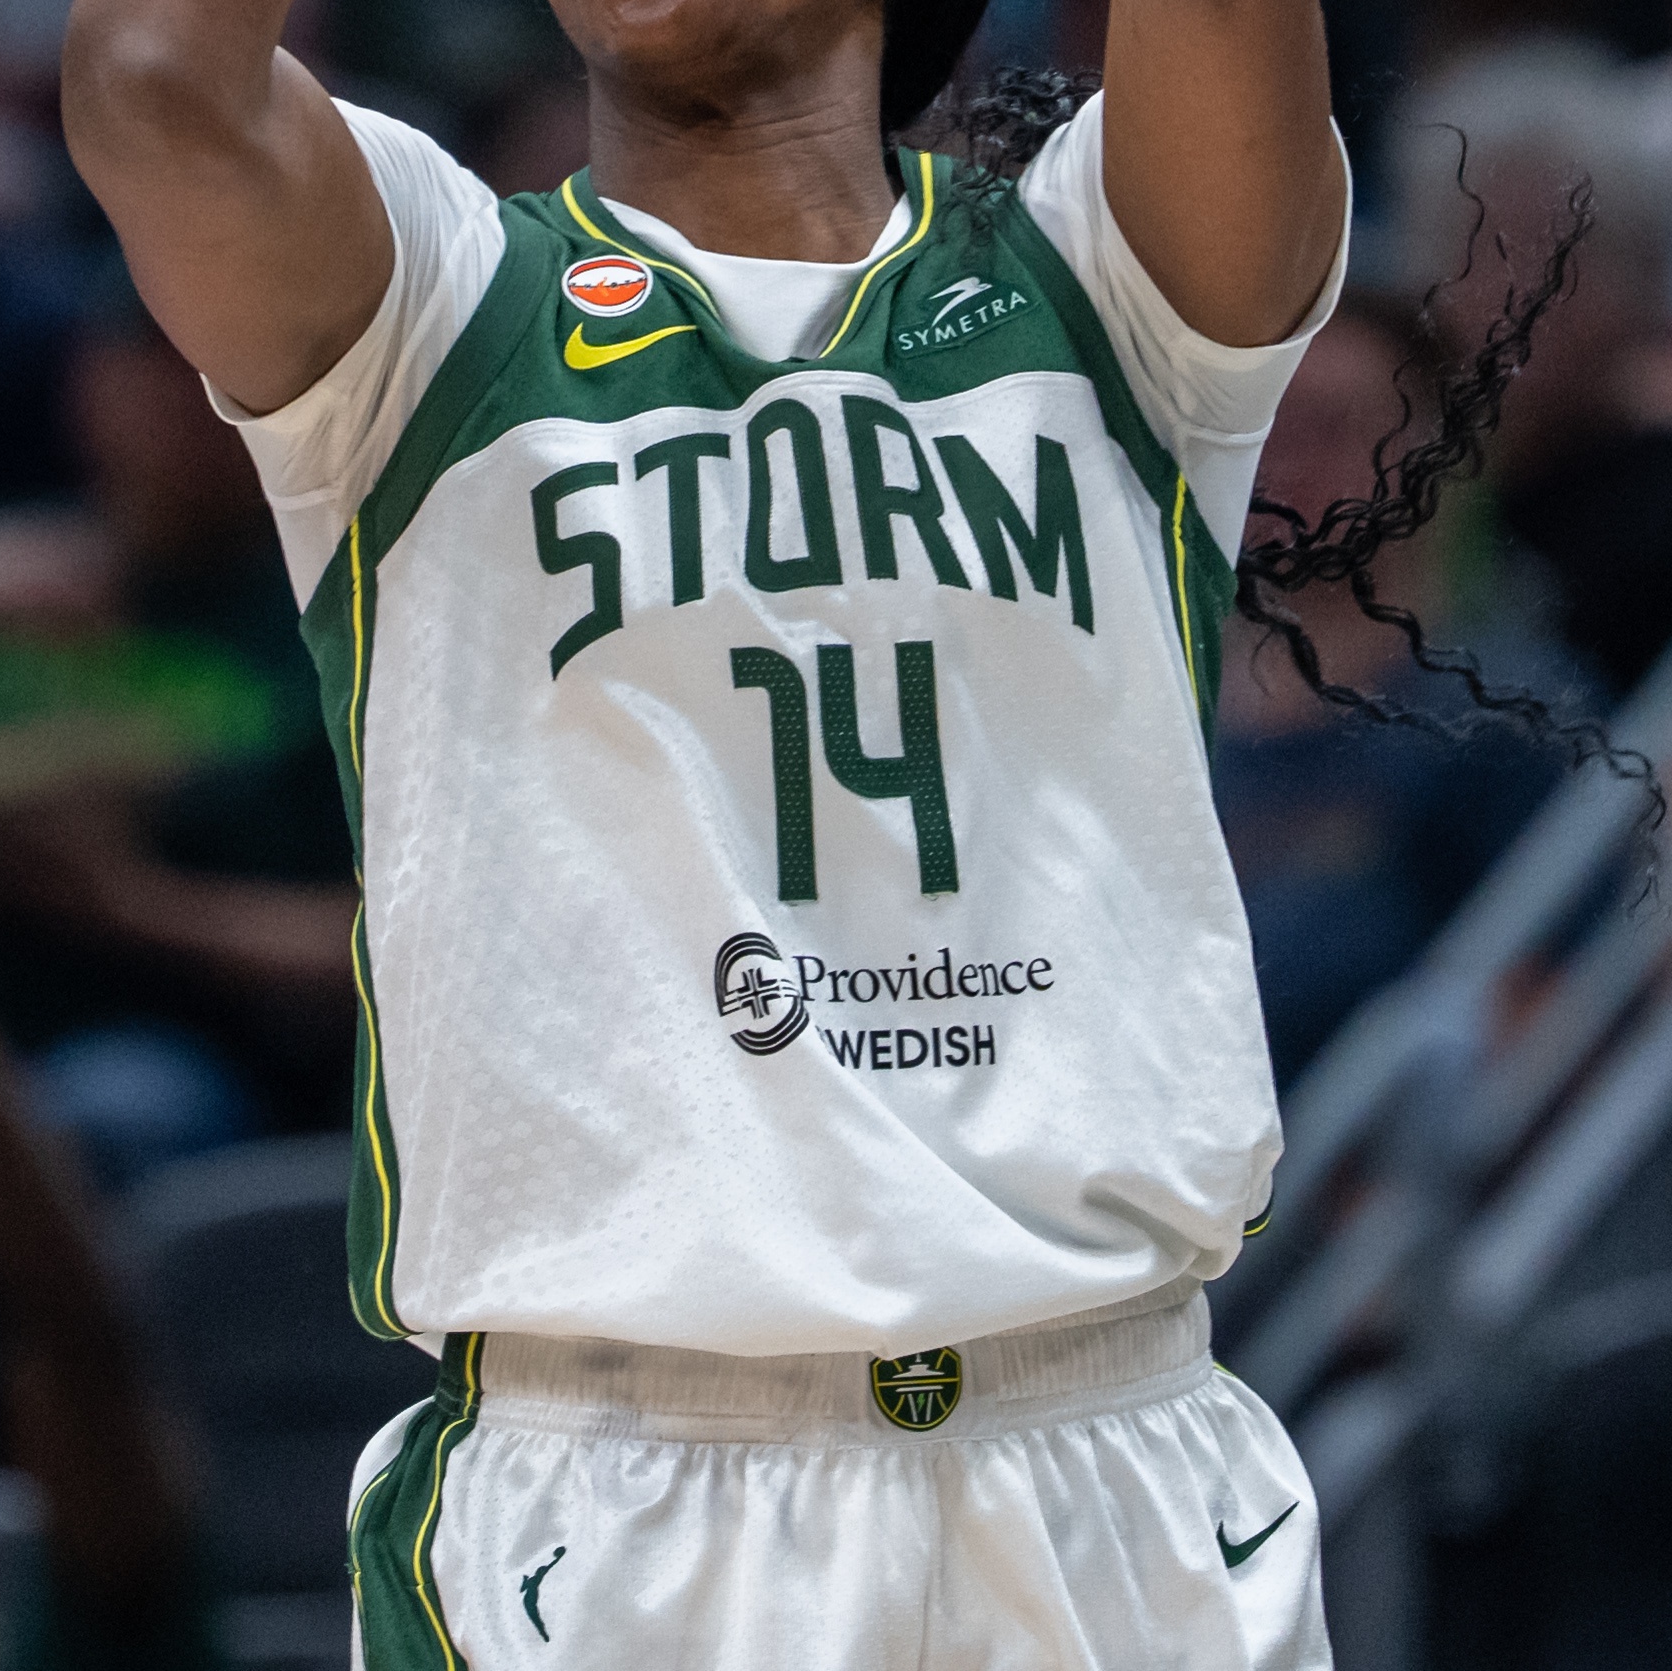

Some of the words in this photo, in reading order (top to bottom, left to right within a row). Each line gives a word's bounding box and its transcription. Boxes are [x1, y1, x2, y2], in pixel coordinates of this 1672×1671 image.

[898, 290, 1028, 351] SYMETRA
[531, 394, 1095, 681] STORM
[730, 640, 960, 902] 14
[792, 947, 1055, 1003] Providence
[815, 1024, 996, 1070] WEDISH
